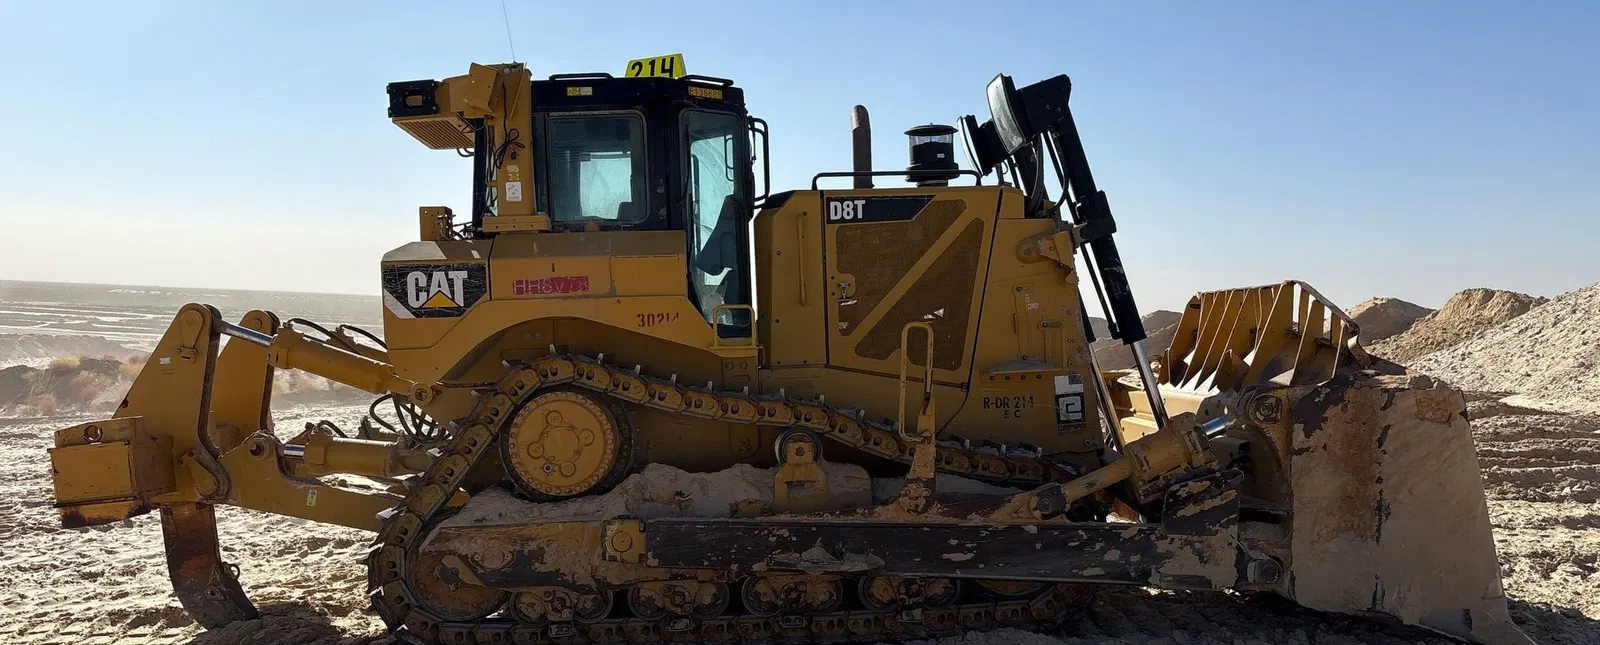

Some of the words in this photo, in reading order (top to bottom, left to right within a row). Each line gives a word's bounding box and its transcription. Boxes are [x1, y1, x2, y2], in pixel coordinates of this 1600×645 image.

[631, 56, 675, 78] 214
[829, 199, 866, 221] D8T
[406, 270, 468, 308] CAT
[983, 396, 1010, 409] R-DR
[1013, 395, 1035, 409] 214
